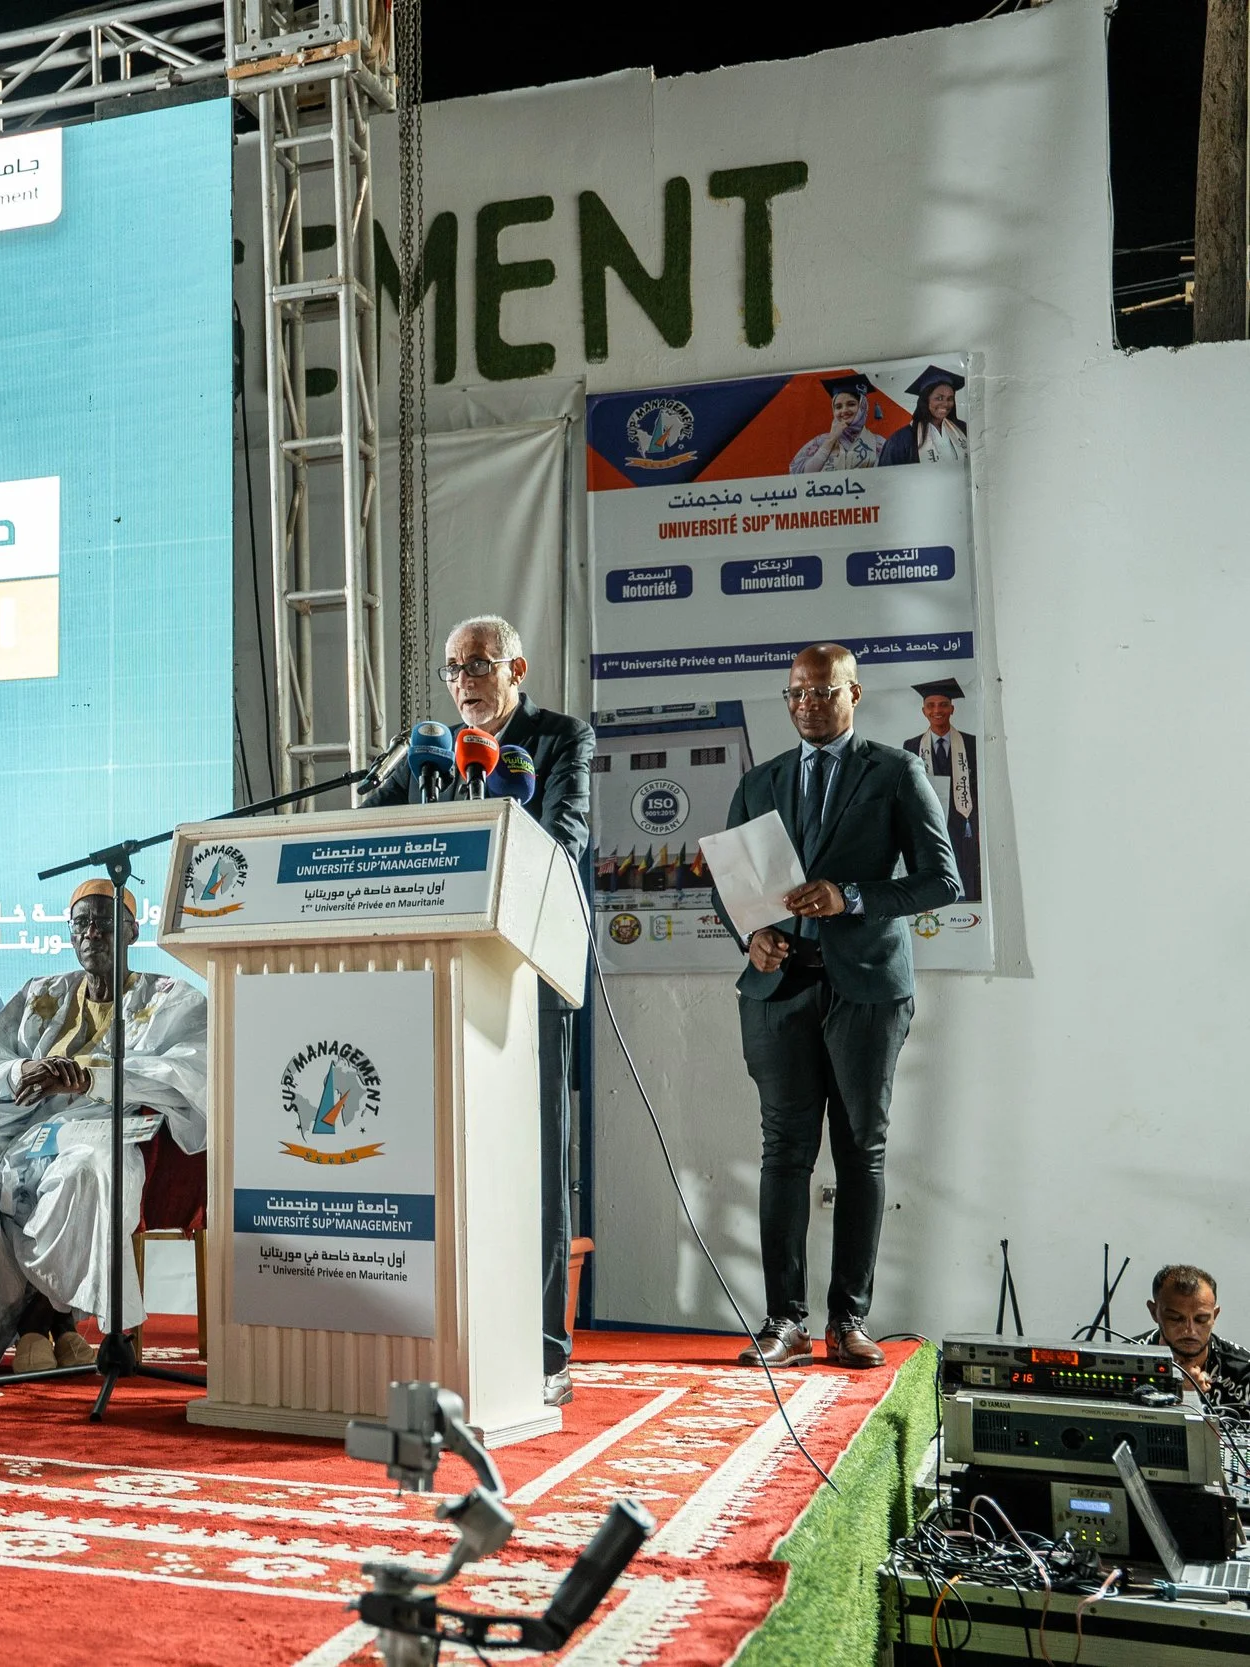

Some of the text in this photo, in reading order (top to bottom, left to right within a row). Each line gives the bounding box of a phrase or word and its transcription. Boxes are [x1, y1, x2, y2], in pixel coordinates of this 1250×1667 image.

[635, 399, 694, 438] MANAGEMENT
[668, 477, 866, 511] جامعة سيب منجمنت
[659, 514, 738, 540] UNIVERSITÉ
[875, 549, 919, 566] التميز
[627, 569, 671, 581] السمعة
[741, 574, 804, 590] Innovation
[868, 564, 938, 582] Excellence
[622, 580, 677, 598] Notoriété
[855, 637, 961, 658] أول جامعة خاصة في
[621, 658, 677, 670] Université
[680, 656, 715, 667] Privée
[718, 656, 732, 665] en
[734, 651, 798, 663] Mauritanie
[640, 782, 680, 796] CERTIFIED
[648, 798, 674, 809] ISO
[640, 819, 680, 833] COMPANY
[312, 838, 447, 861] جامعة سيب منجمنت
[195, 844, 248, 887] MANAGEMENT
[296, 861, 355, 876] UNIVERSITÉ
[304, 879, 445, 901] أول جامعة خاصة في موريتانيا
[136, 898, 162, 925] ول
[315, 902, 355, 912] Université
[357, 900, 383, 910] Privée
[398, 897, 444, 908] Mauritanie
[292, 1040, 381, 1116] MANAGEMENT
[266, 1197, 398, 1218] جامعة سيب منجمنت
[253, 1215, 310, 1228] UNIVERSITÉ
[260, 1245, 406, 1268] أول جامعة خاصة في موريتانيا
[273, 1264, 315, 1277] Université
[317, 1267, 344, 1278] Privée
[346, 1271, 357, 1279] en
[359, 1270, 408, 1281] Mauritanie
[1012, 1373, 1033, 1383] 216
[988, 1400, 1010, 1409] YAMAHA
[1076, 1515, 1105, 1526] 7211
